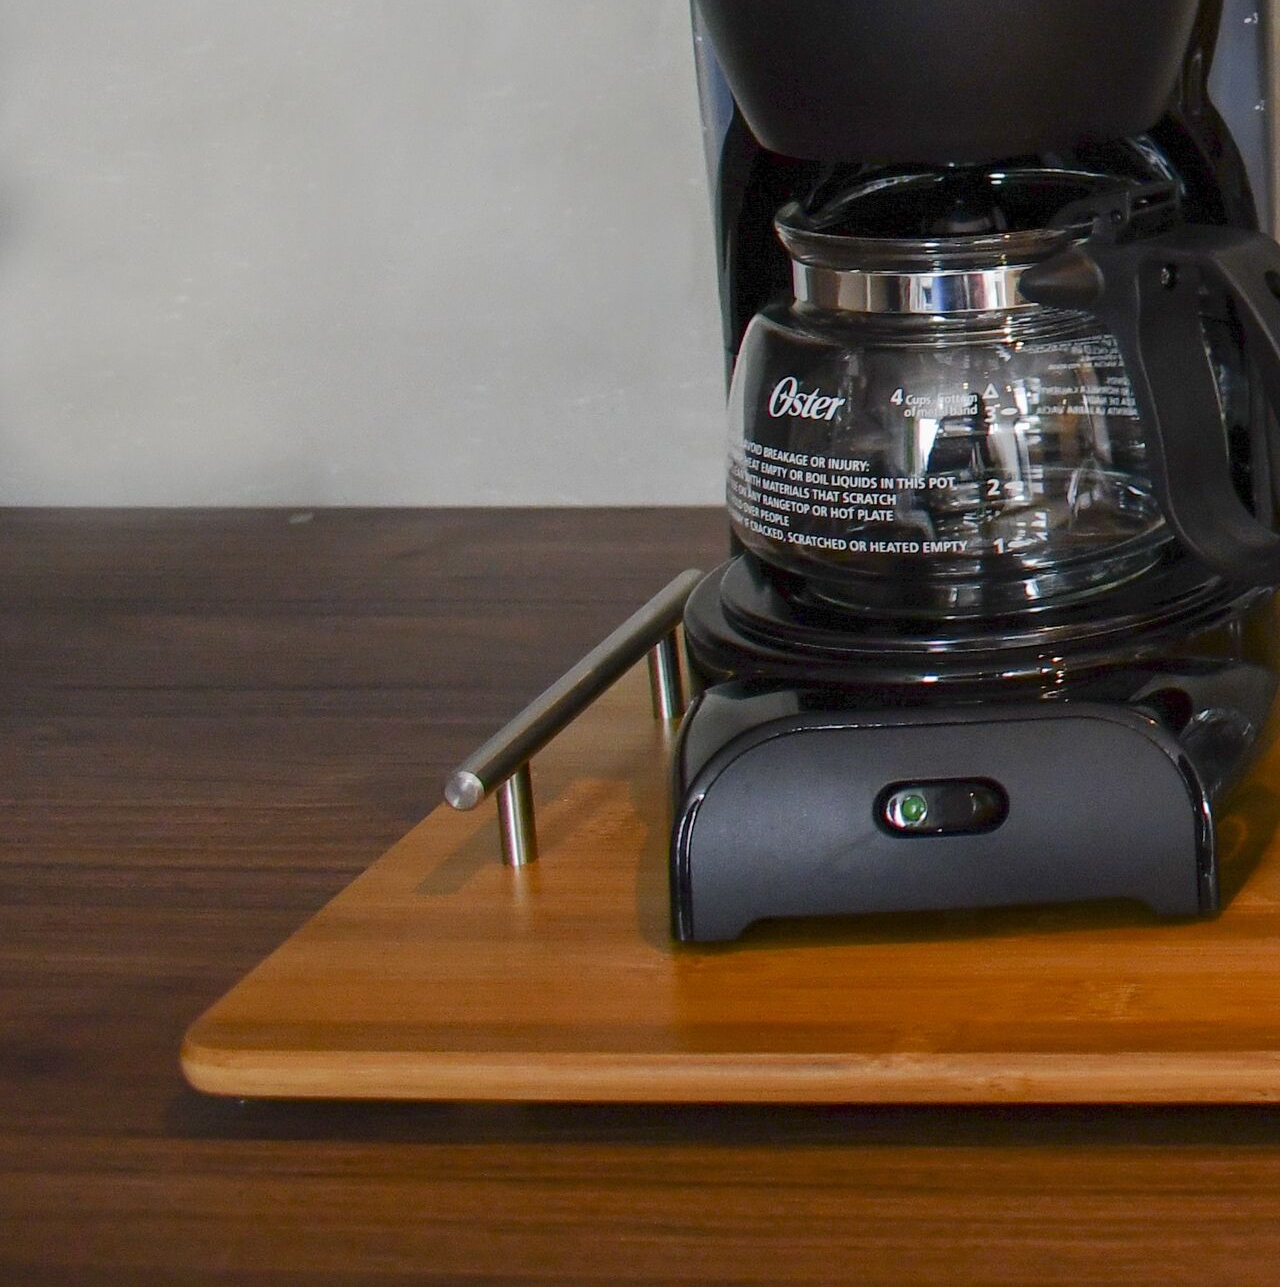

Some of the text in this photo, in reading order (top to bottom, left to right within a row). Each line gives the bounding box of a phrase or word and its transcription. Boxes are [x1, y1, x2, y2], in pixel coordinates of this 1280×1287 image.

[768, 376, 846, 420] Oster
[890, 388, 903, 405] 4
[904, 407, 916, 417] of
[763, 447, 809, 466] BREAKAGE
[810, 456, 826, 468] OR
[828, 458, 870, 472] INJURY:
[761, 463, 788, 479] EMPTY
[789, 469, 804, 482] OR
[805, 472, 830, 486] BOIL
[831, 475, 878, 489] LIQUIDS
[881, 478, 895, 489] IN
[897, 477, 926, 490] THIS
[987, 479, 1000, 497] 2
[762, 478, 810, 498] MATERIALS
[812, 488, 840, 502] THAT
[842, 492, 897, 506] SCRATCH
[760, 509, 790, 527] PEOPLE
[763, 494, 811, 514] RANGETOP
[812, 505, 828, 517] OR
[831, 507, 855, 520] HOT
[858, 509, 894, 522] PLATE
[750, 520, 787, 542] CRACKED,
[788, 532, 847, 550] SCRATCHED
[849, 539, 867, 553] OR
[869, 540, 919, 554] HEATED
[923, 541, 968, 554] EMPTY
[993, 538, 1004, 554] 1
